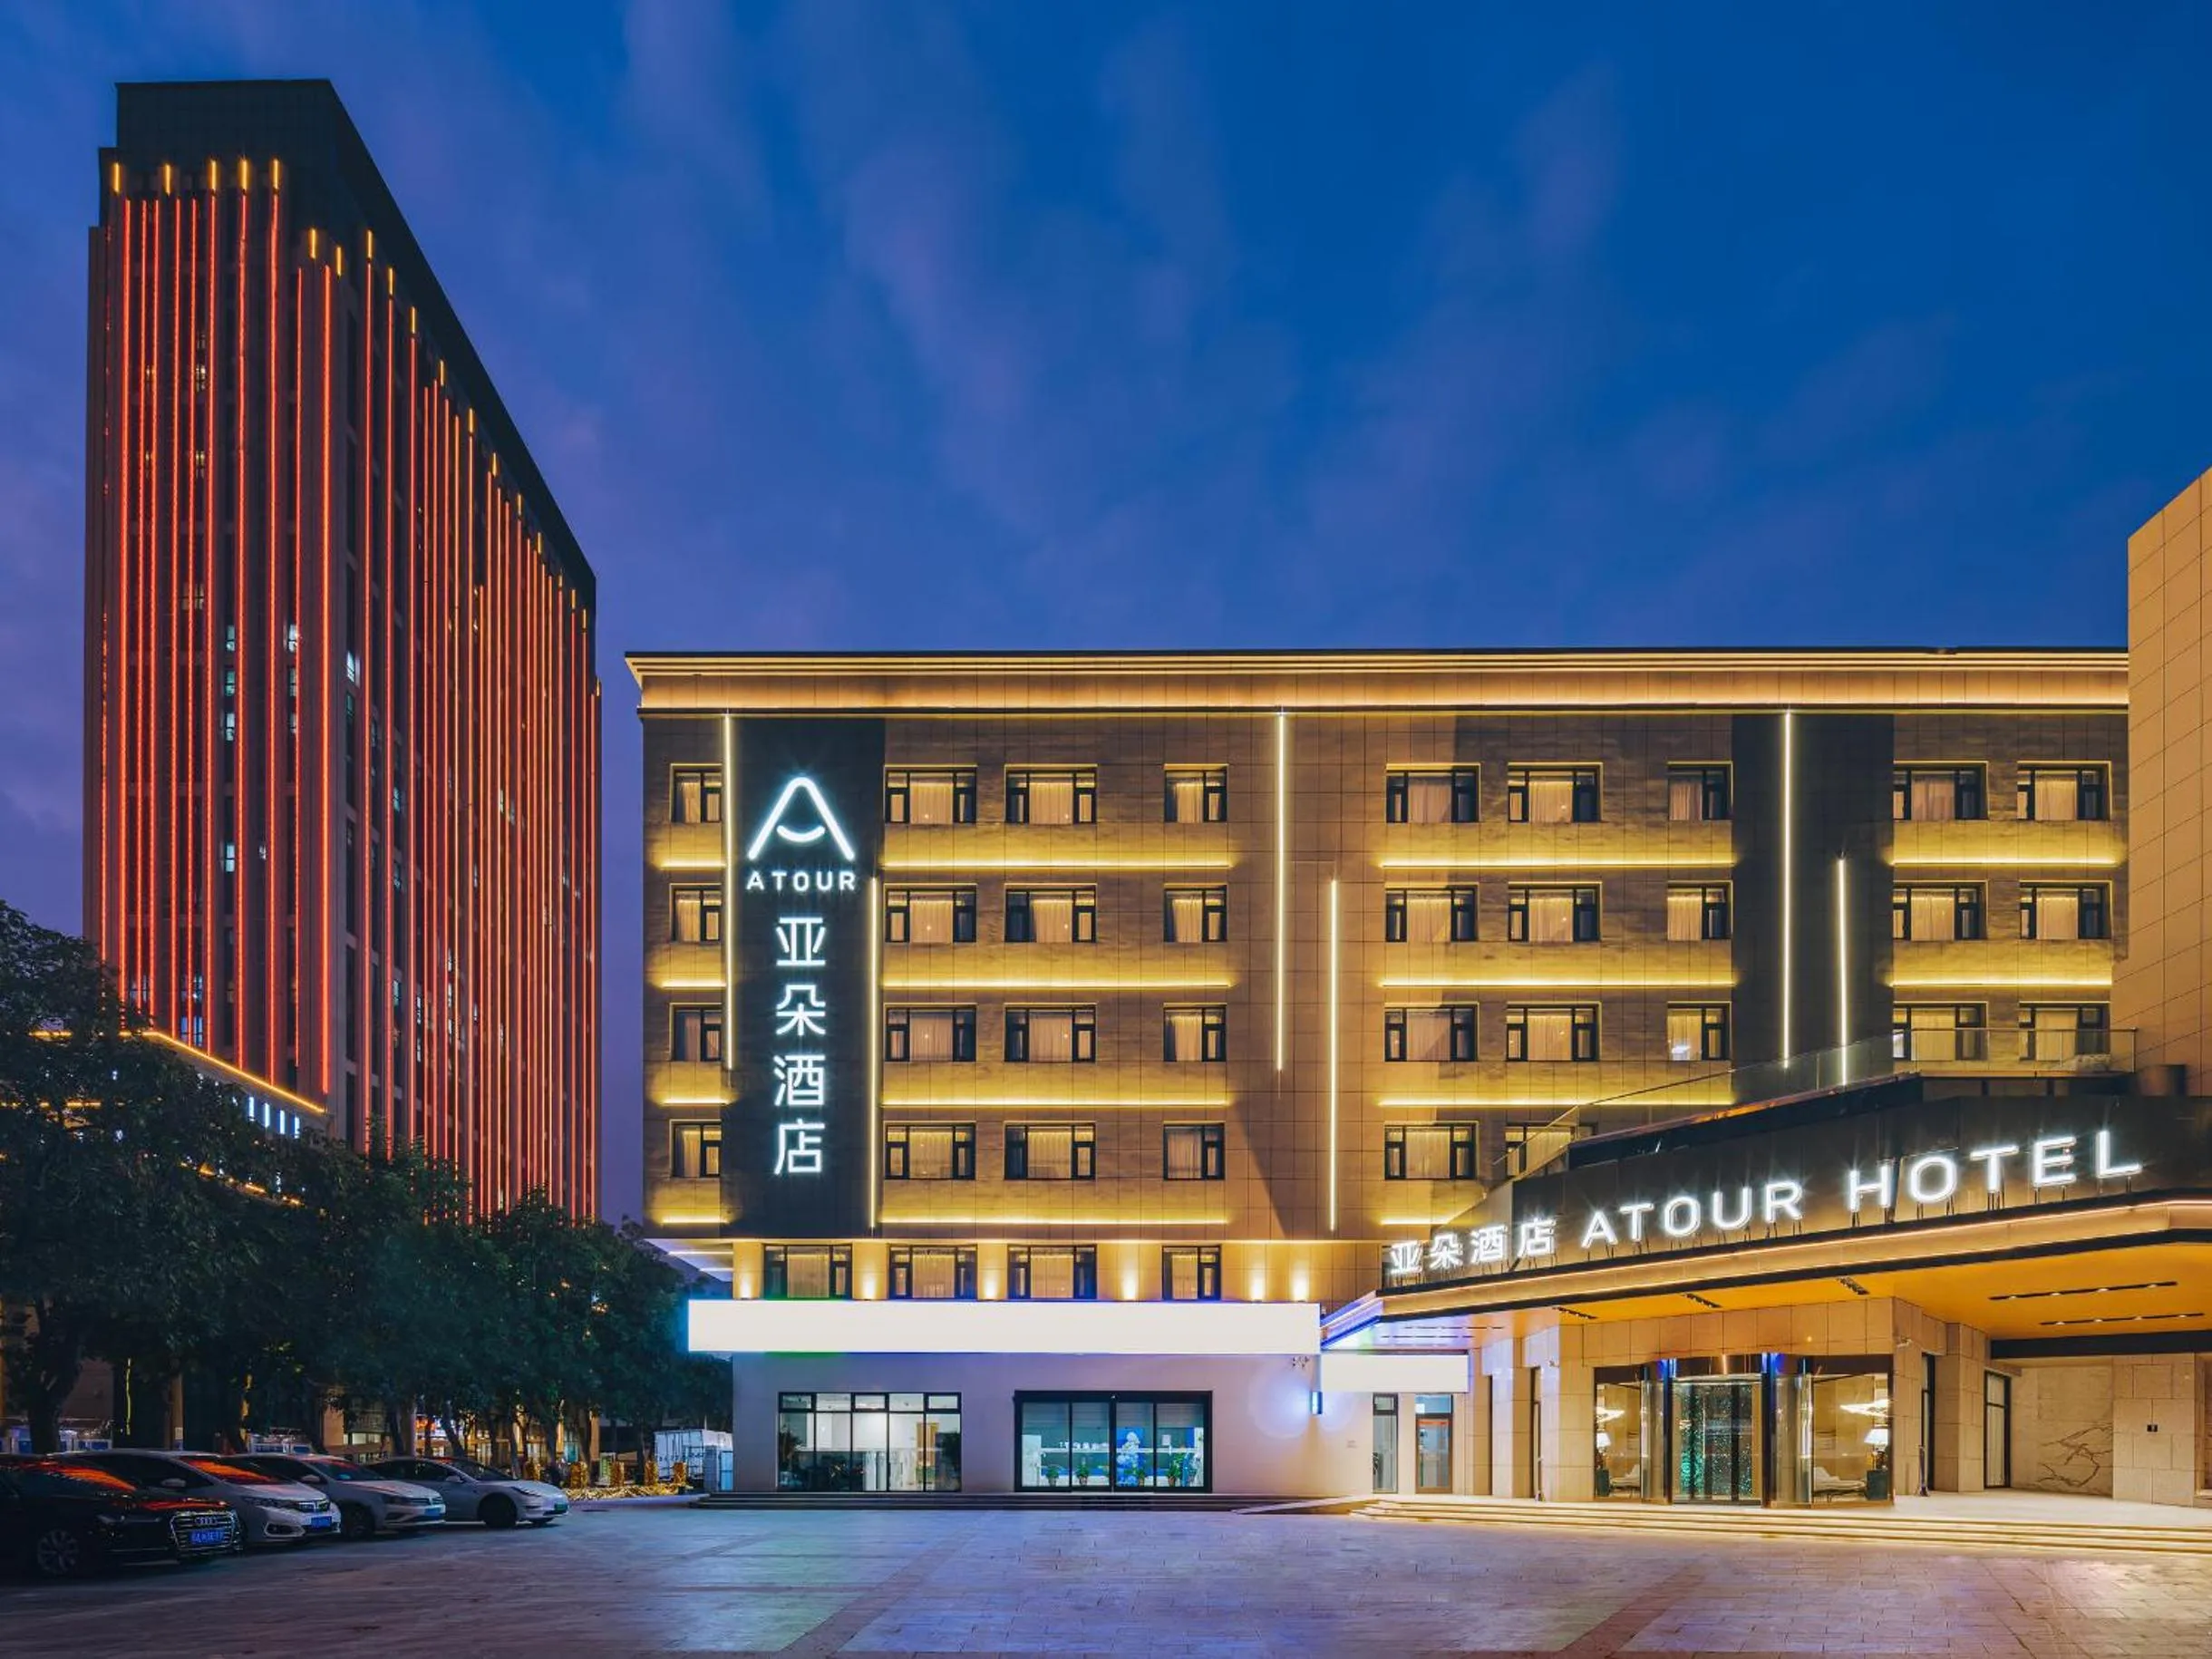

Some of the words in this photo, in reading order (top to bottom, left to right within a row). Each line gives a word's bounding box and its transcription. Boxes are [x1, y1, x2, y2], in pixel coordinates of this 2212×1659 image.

[746, 870, 856, 892] ATOUR
[774, 917, 826, 1176] 亚朵酒店
[1390, 1217, 1557, 1273] 亚朵酒店
[1580, 1181, 1803, 1248] ATOUR
[1848, 1130, 2142, 1213] HOTEL
